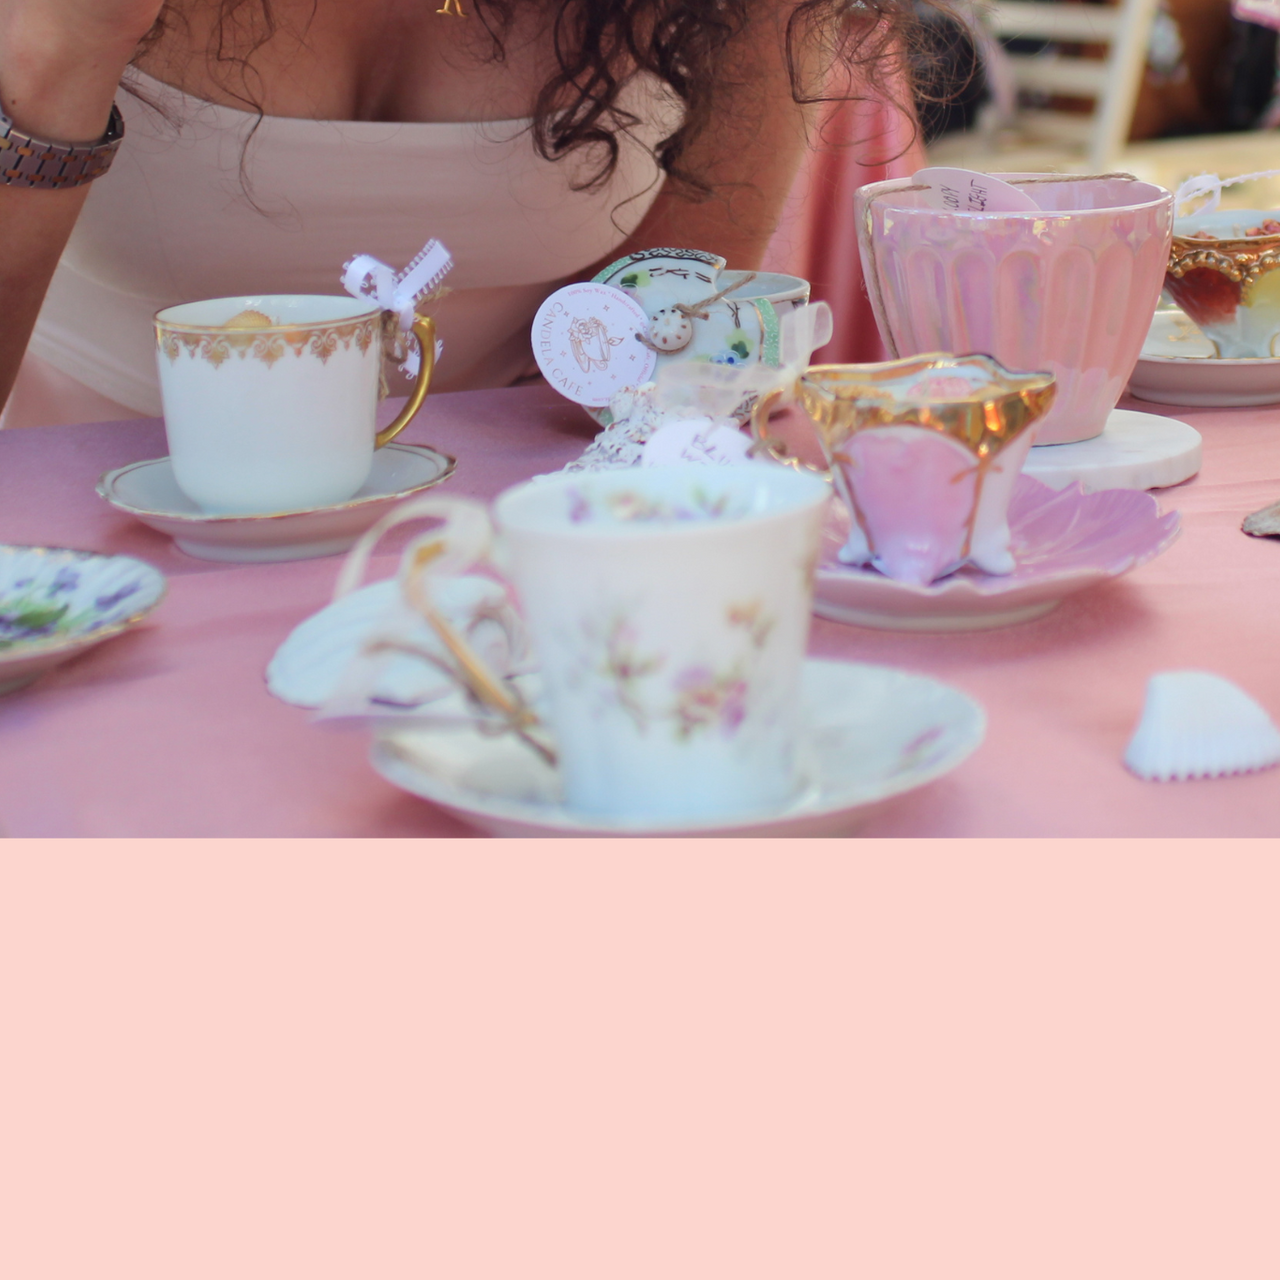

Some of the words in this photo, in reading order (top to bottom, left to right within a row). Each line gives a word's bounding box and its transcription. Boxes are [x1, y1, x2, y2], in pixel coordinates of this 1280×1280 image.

[967, 179, 988, 212] LIGHT
[610, 292, 641, 318] Handcrafted
[540, 301, 565, 367] CANDELA
[551, 367, 584, 397] CAFE
